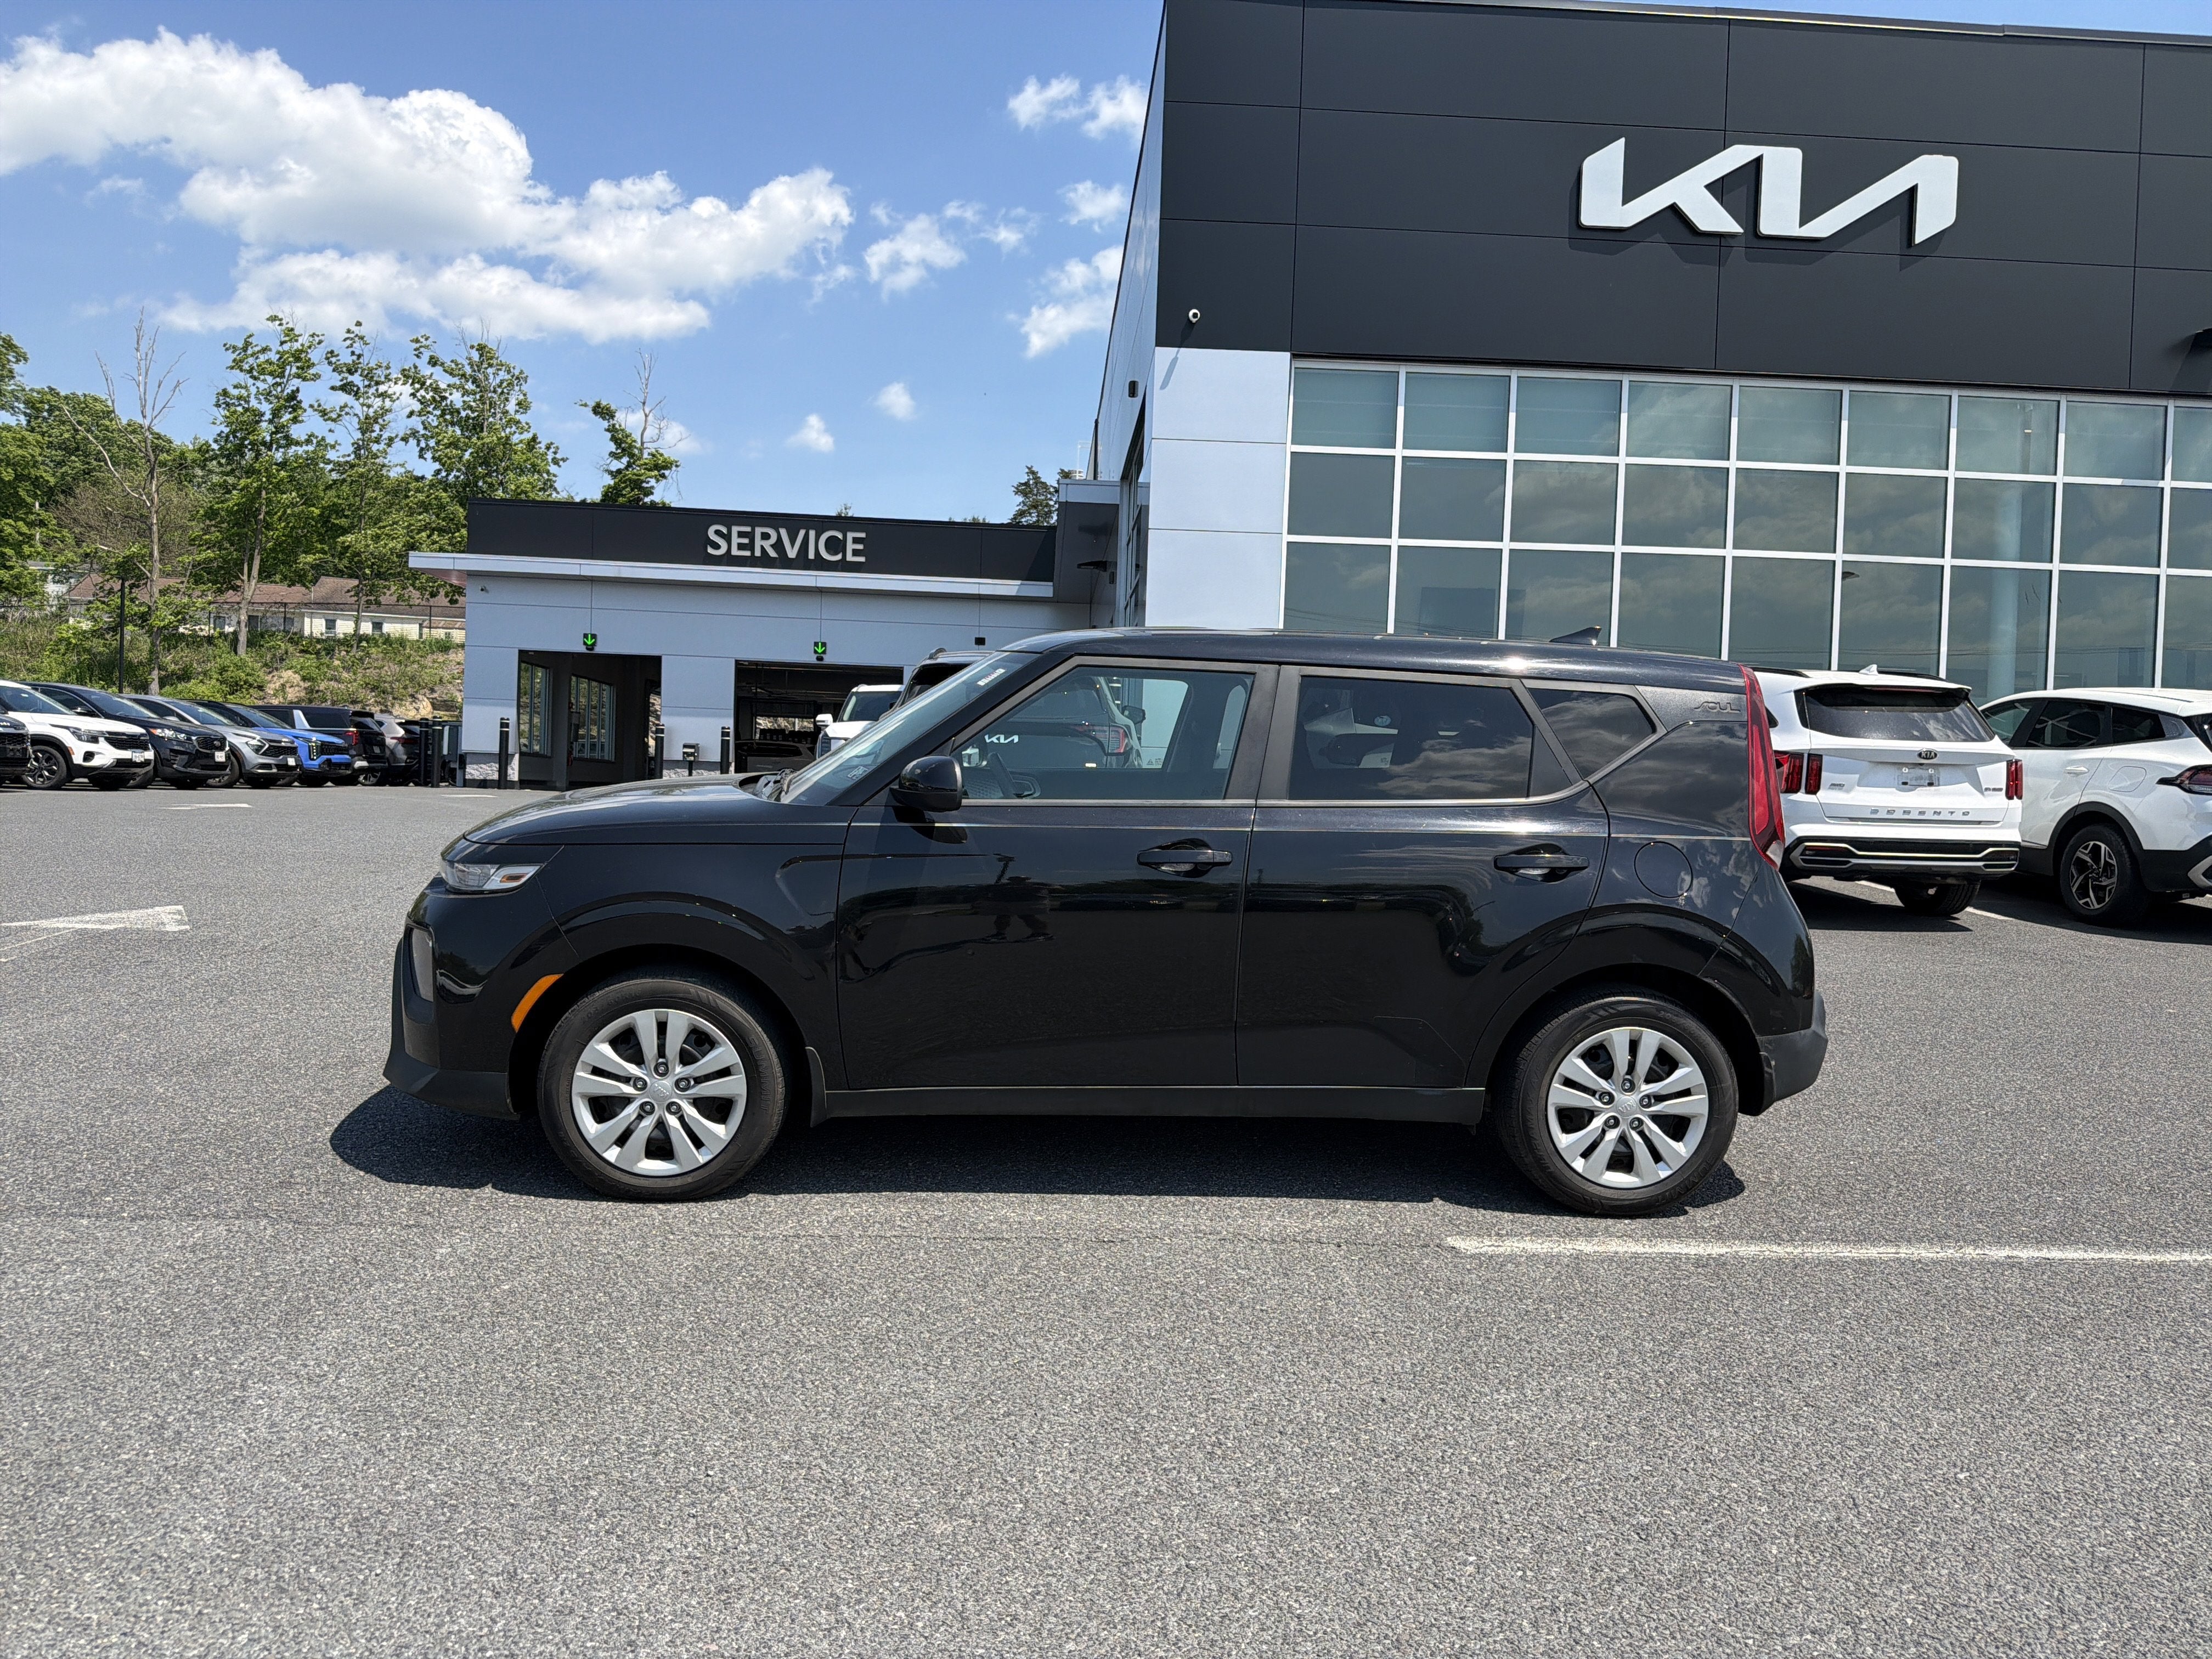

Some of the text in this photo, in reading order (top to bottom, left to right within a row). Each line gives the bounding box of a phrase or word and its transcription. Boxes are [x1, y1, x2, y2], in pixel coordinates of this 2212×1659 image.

[1579, 136, 1959, 247] KIA
[707, 524, 866, 562] SERVICE
[1693, 701, 1741, 713] SOUL
[984, 733, 1019, 743] KIA
[1870, 808, 1970, 816] SORENTO
[746, 1036, 771, 1115] SUMMIT
